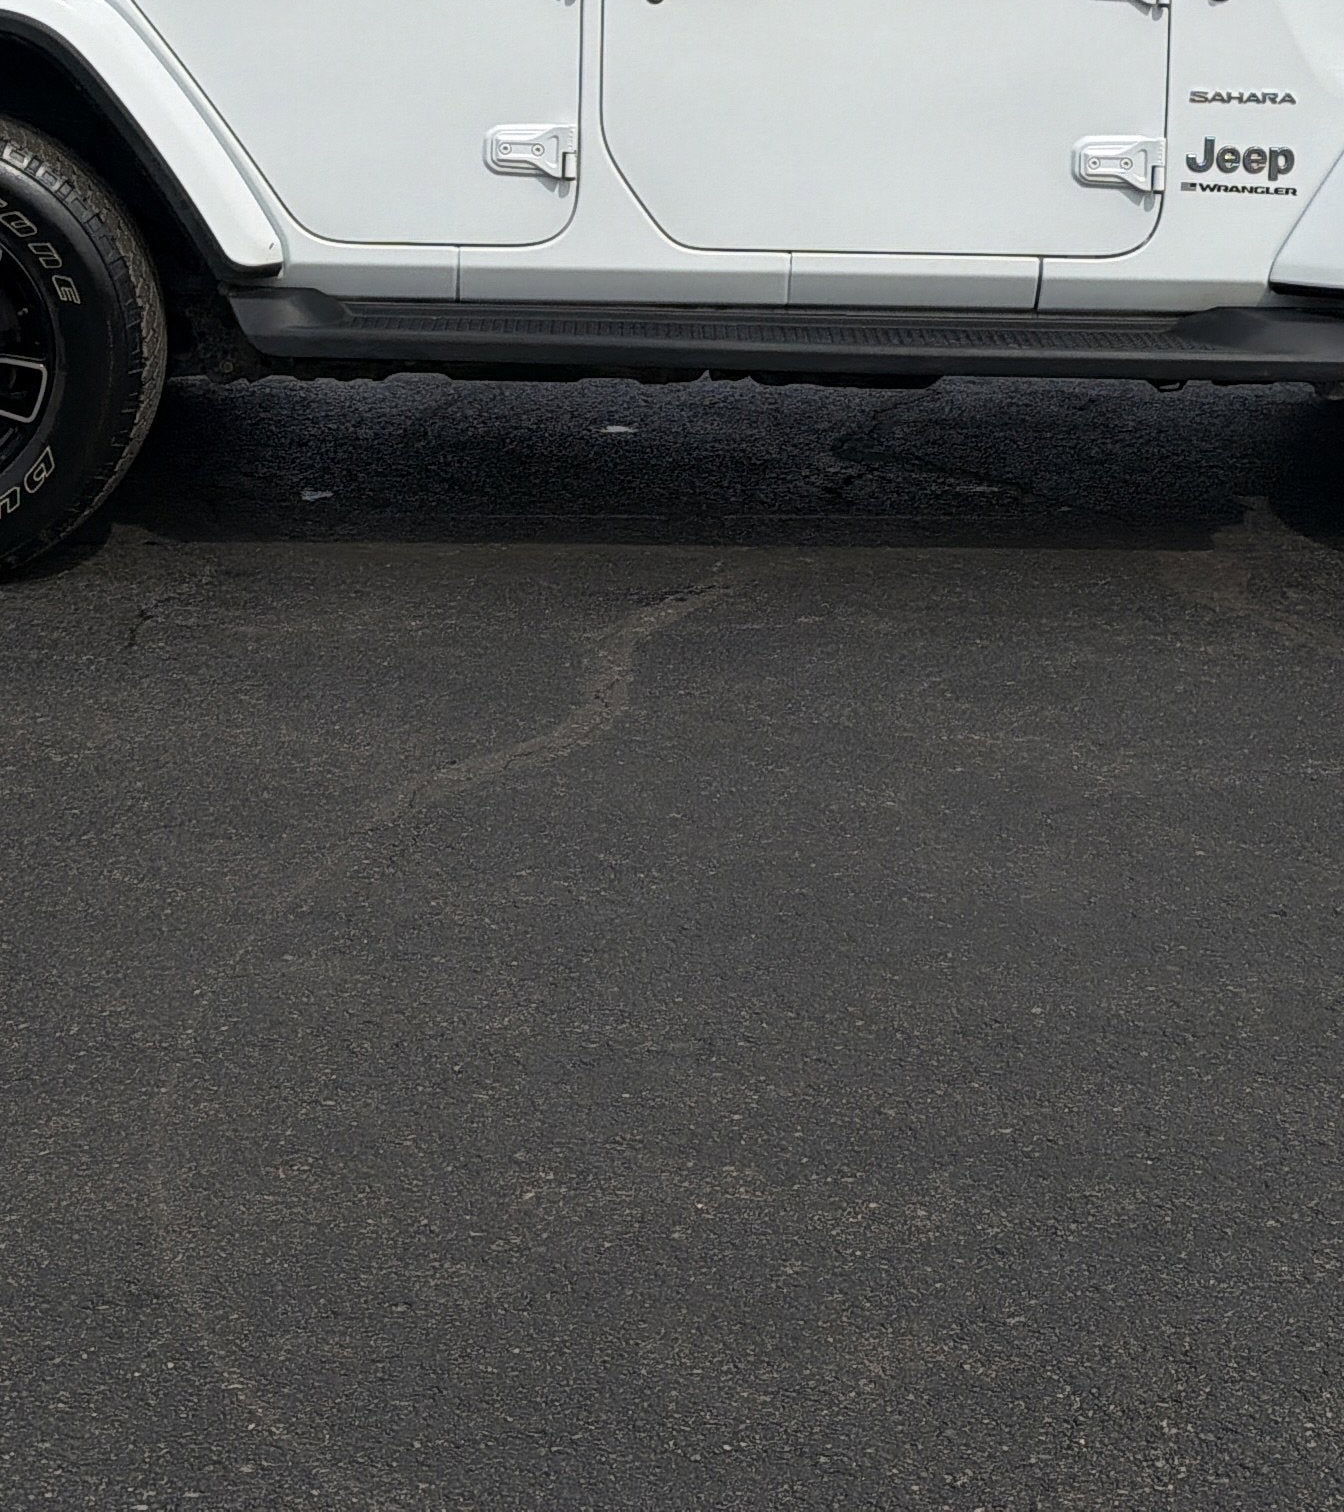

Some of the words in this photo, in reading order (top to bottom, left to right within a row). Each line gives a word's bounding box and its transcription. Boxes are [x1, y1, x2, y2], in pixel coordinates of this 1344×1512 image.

[1189, 91, 1297, 105] SAHARA
[1186, 136, 1295, 181] Jeep
[1199, 183, 1298, 196] WRANGLER
